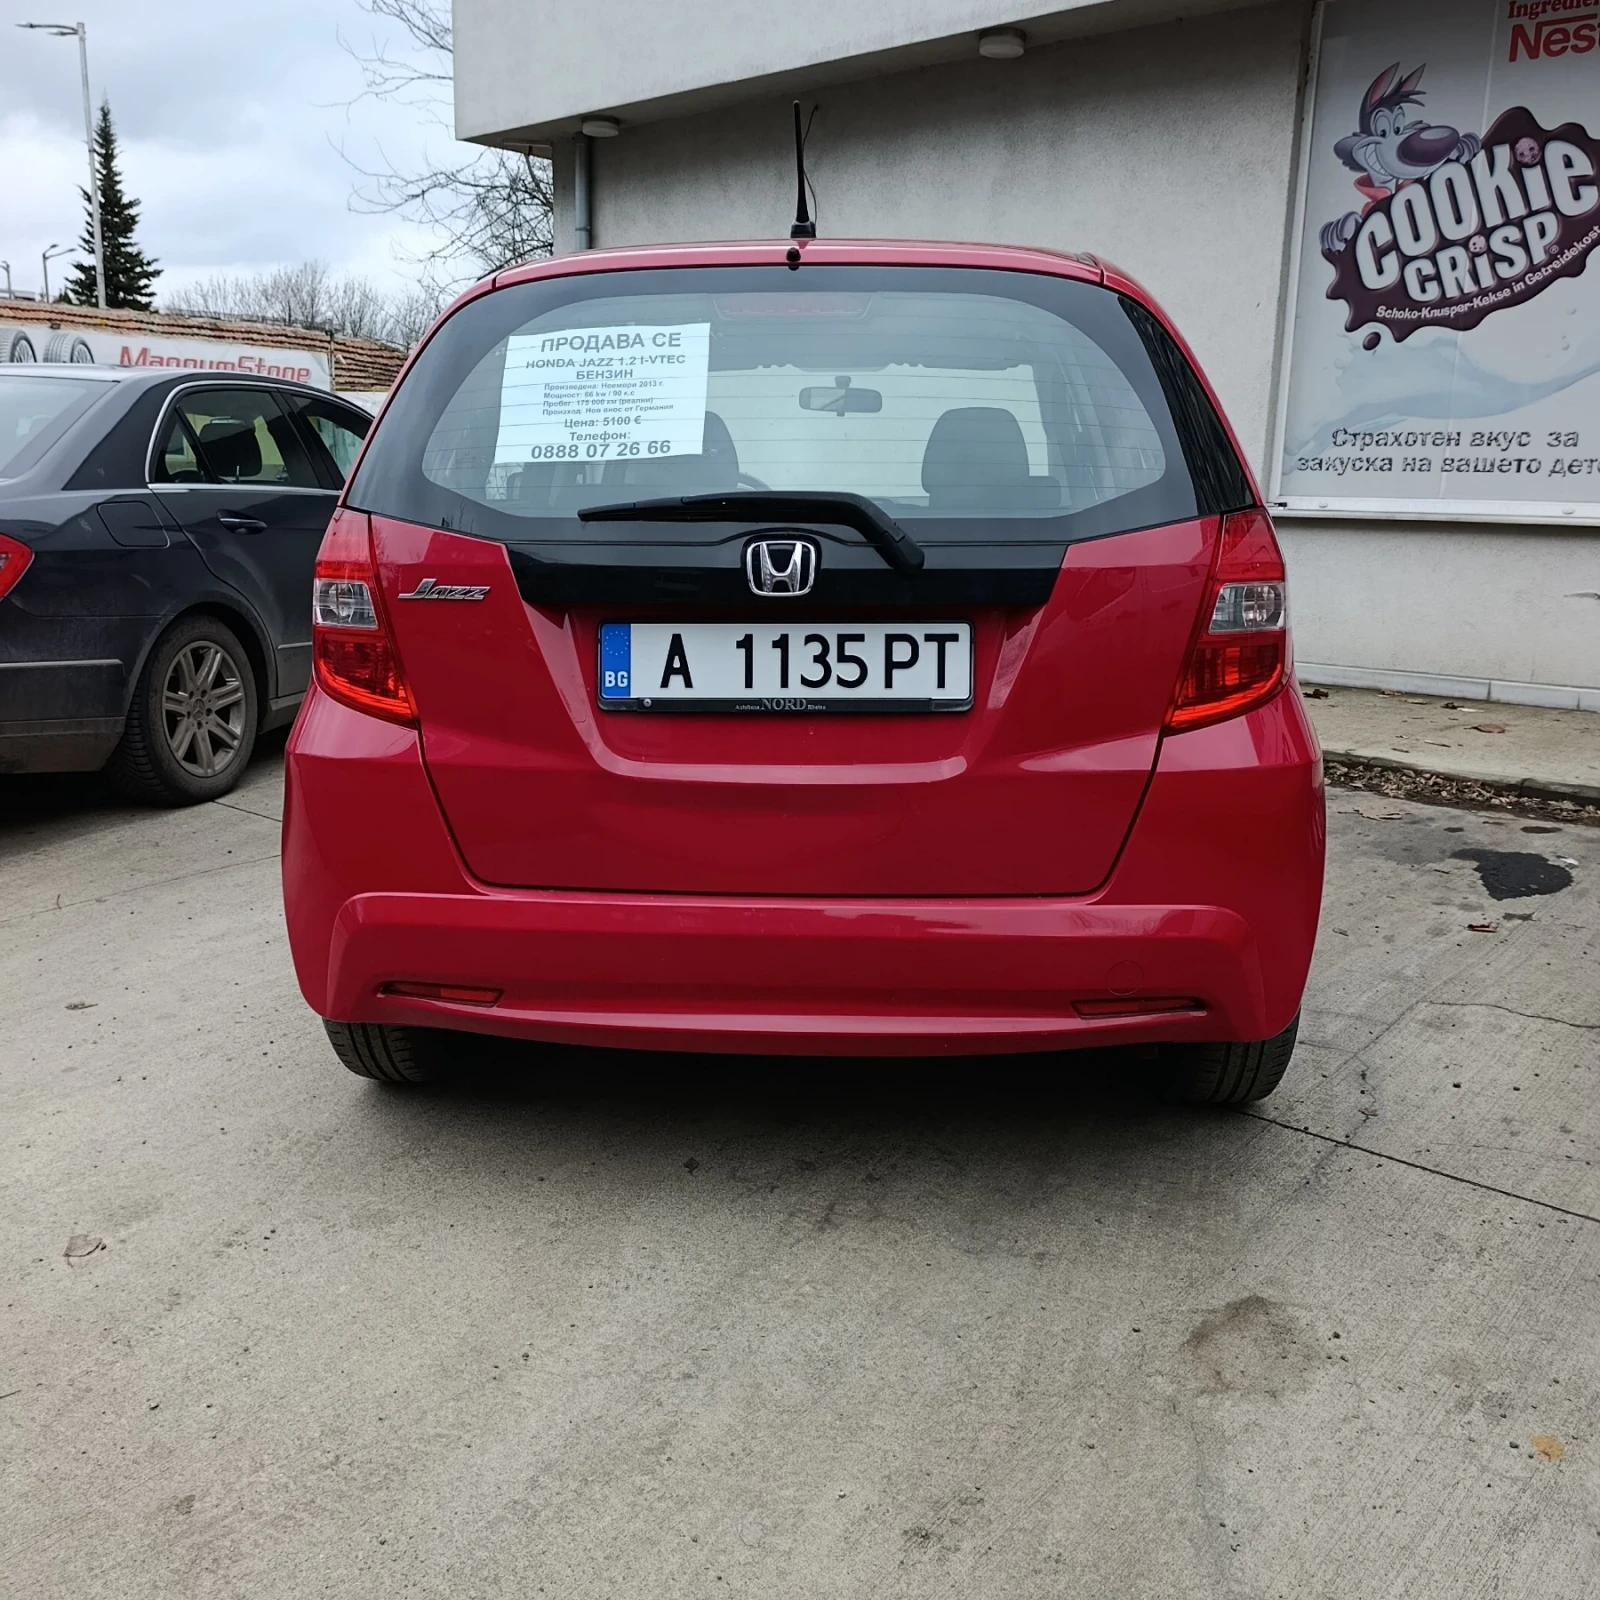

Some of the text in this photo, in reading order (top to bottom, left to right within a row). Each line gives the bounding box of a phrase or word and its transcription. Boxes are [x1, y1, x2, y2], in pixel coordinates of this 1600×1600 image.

[1508, 13, 1600, 63] Nes
[1376, 287, 1511, 320] Schoko-Knusper-Kekse
[1512, 281, 1526, 294] in
[540, 332, 682, 353] ПРОДАВА СЕ
[525, 358, 576, 369] HONDA
[578, 357, 615, 368] JAZZ
[575, 369, 634, 380] БЕНЗИН
[639, 380, 658, 388] 2013
[591, 398, 605, 406] 000
[619, 397, 654, 406] (реални)
[635, 404, 674, 412] Германия
[563, 415, 642, 429] Цена: 5100 €
[569, 430, 632, 443] Телефон:
[1331, 427, 1579, 452] Страхотен вкус за
[531, 440, 672, 459] 0888 07 26 66
[1296, 454, 1600, 478] закуска на вашето дет
[660, 633, 694, 689] A
[604, 670, 629, 688] BG
[760, 698, 807, 711] NORD
